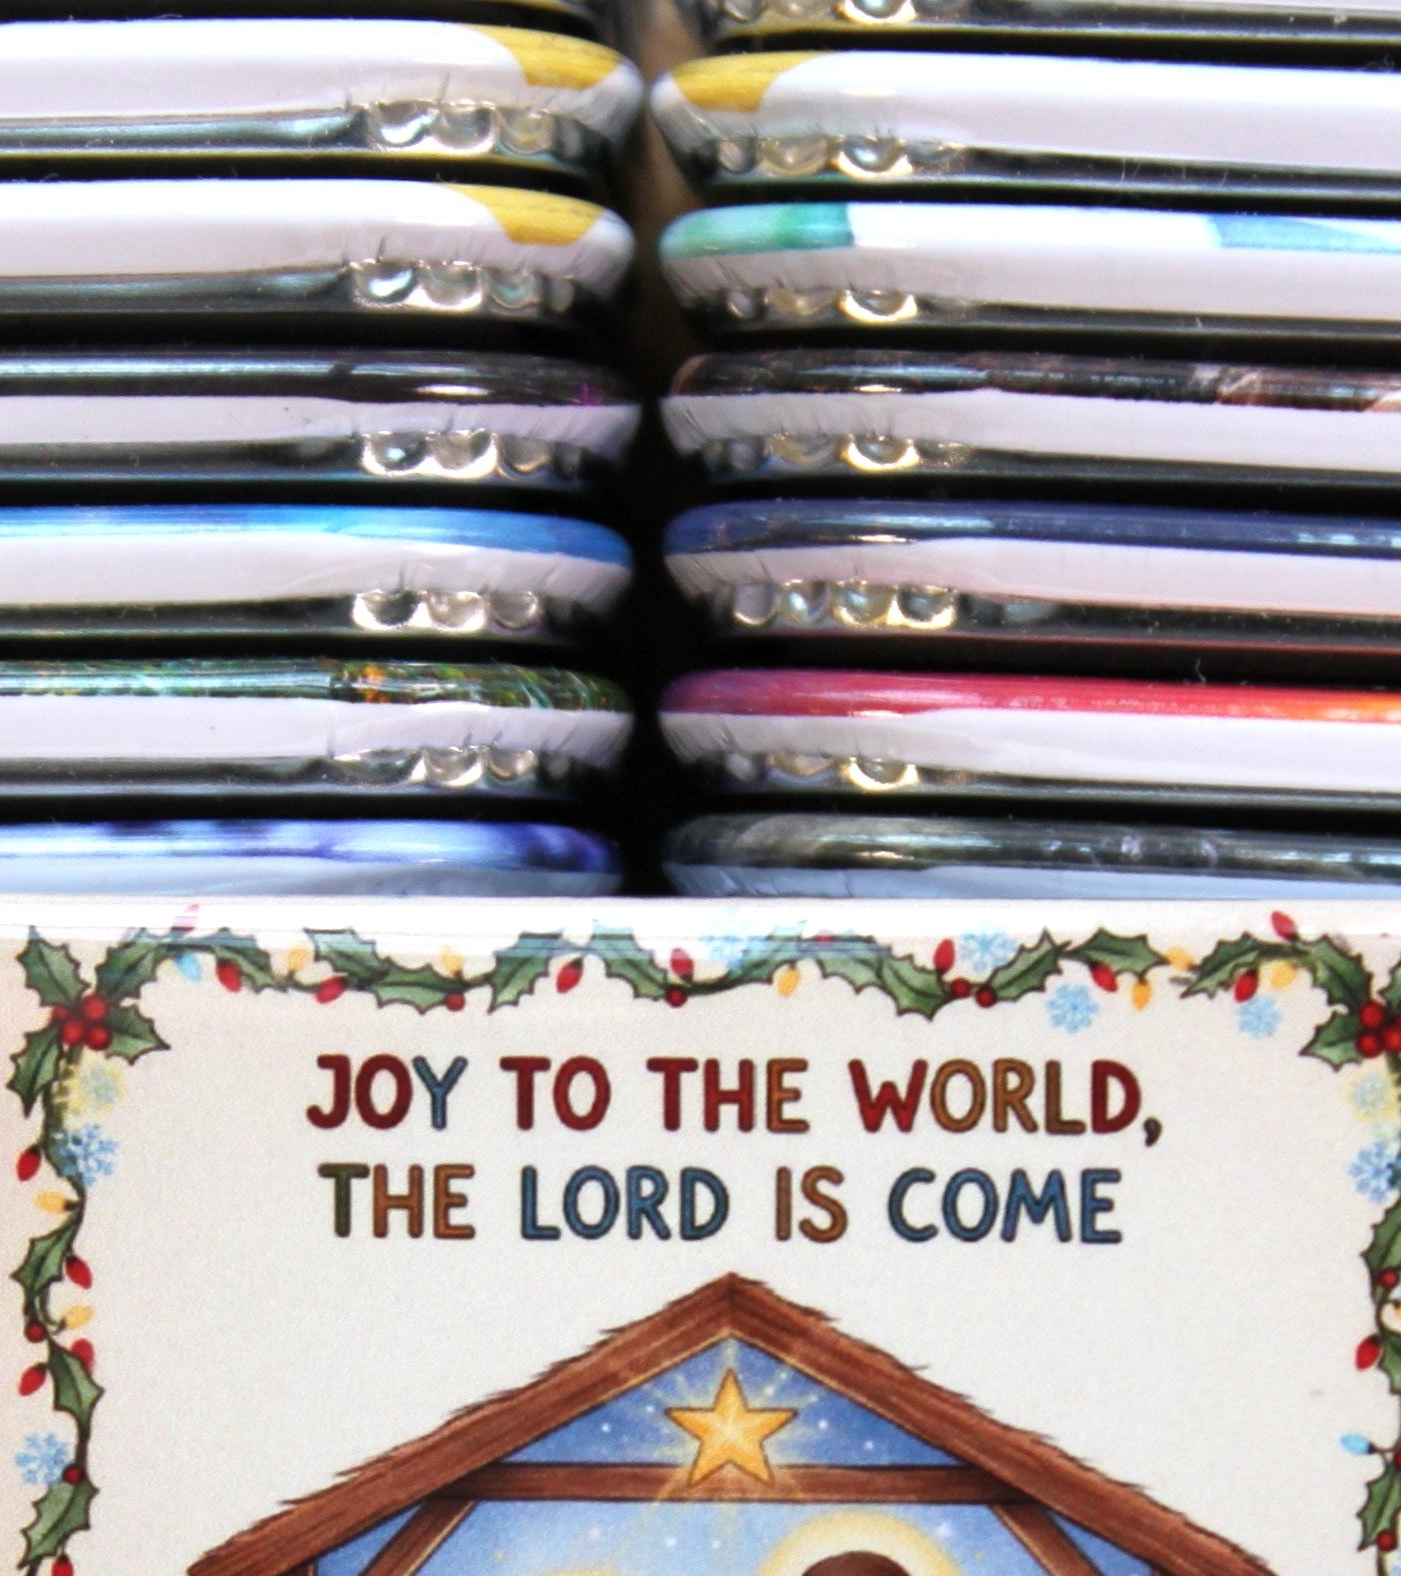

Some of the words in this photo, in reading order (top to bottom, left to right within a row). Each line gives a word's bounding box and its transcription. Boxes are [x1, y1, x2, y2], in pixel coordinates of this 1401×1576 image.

[307, 1054, 468, 1131] JOY
[500, 1056, 611, 1132] TO
[646, 1056, 811, 1134] THE
[848, 1058, 1163, 1147] WORLD,
[318, 1163, 477, 1240] THE
[520, 1164, 731, 1241] LORD
[775, 1166, 850, 1243] IS
[889, 1168, 1123, 1245] COME
